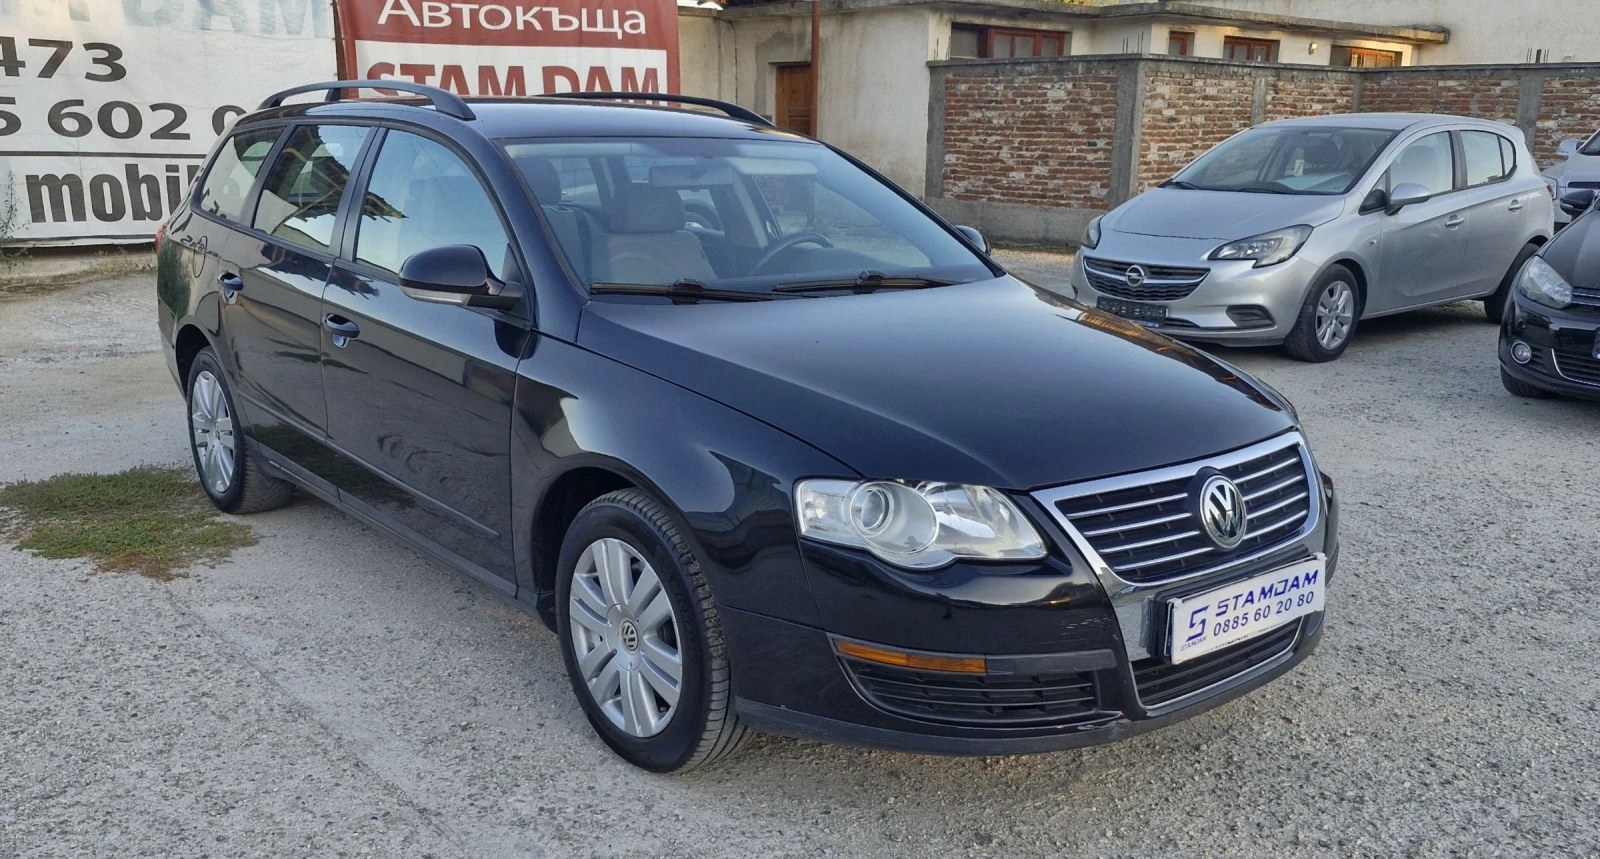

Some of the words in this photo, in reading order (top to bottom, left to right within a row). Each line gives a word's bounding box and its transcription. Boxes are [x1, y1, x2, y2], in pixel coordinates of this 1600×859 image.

[377, 0, 646, 39] Автокъща
[367, 62, 527, 97] STAM
[542, 66, 659, 106] DAM
[47, 99, 191, 141] 602
[1213, 612, 1249, 636] 0885
[1254, 605, 1271, 622] 60
[1276, 598, 1292, 615] 20
[1297, 591, 1314, 607] 80
